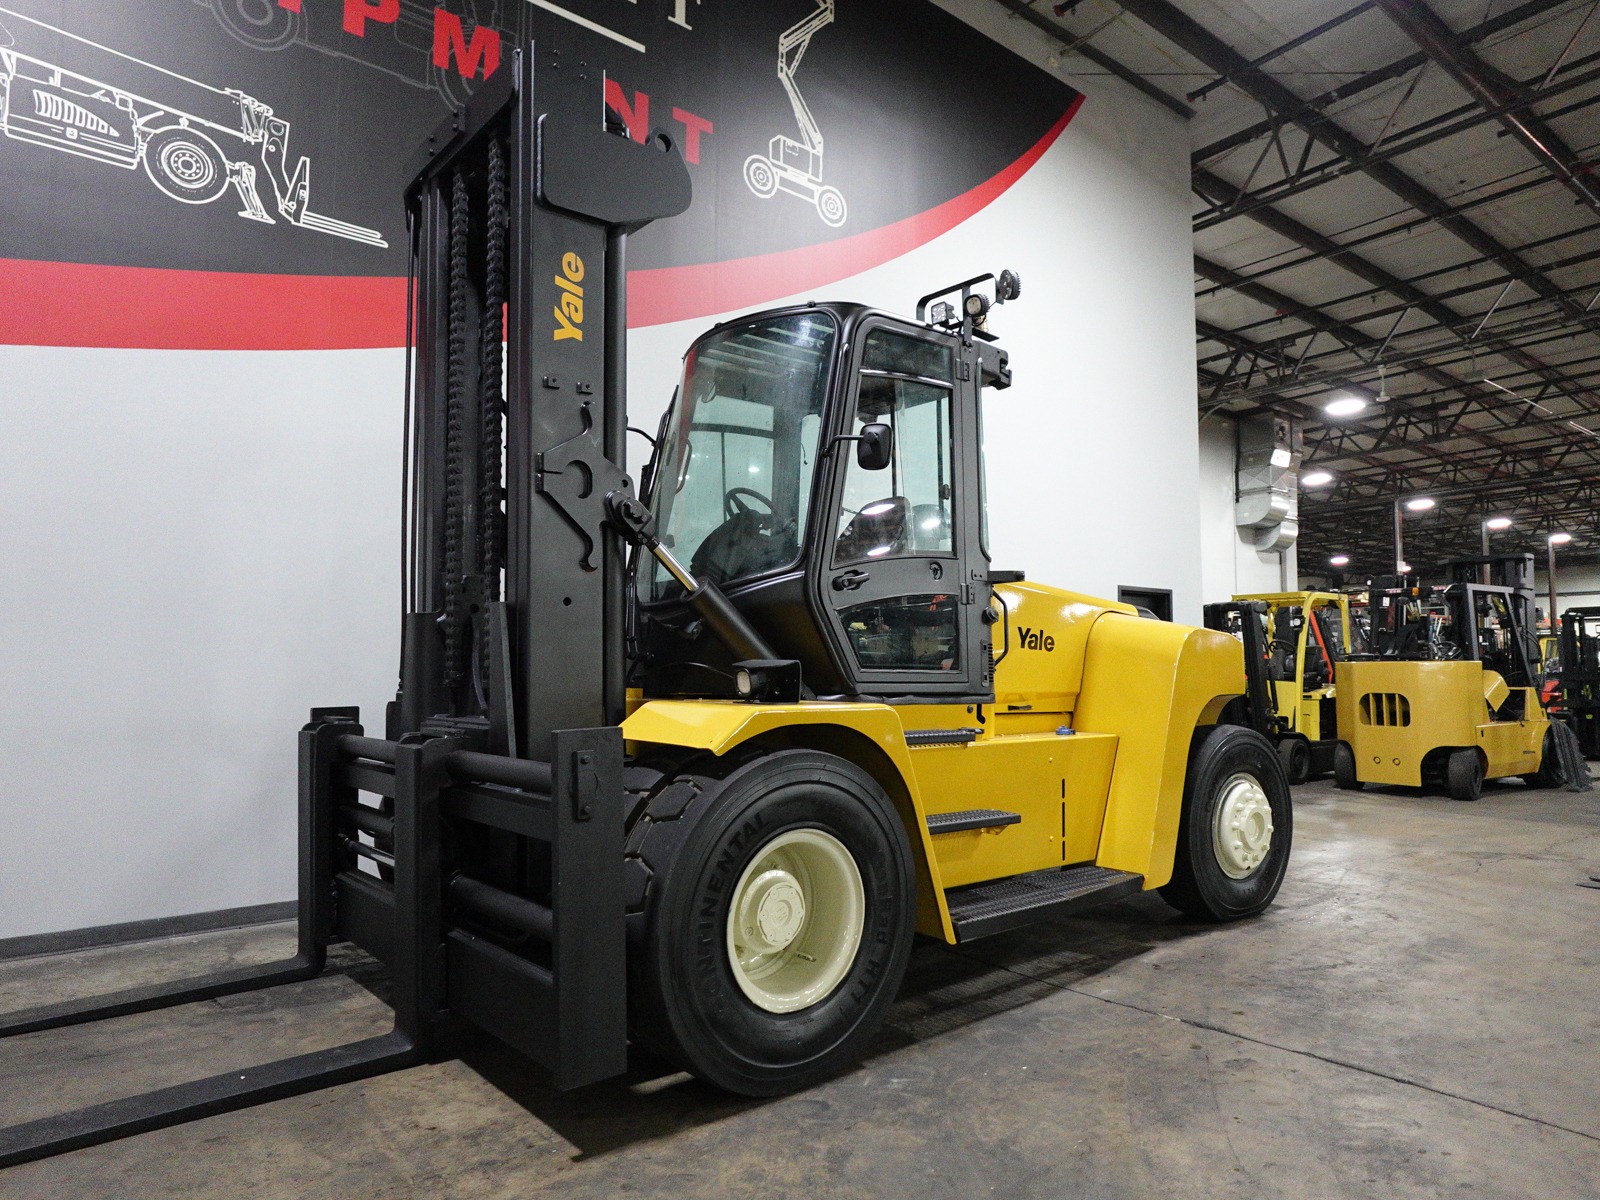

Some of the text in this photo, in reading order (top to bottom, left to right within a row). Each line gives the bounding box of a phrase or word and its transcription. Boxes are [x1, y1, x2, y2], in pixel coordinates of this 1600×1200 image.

[554, 251, 585, 342] Yale
[1017, 626, 1055, 652] Yale
[699, 812, 769, 1016] ONTINENTAL
